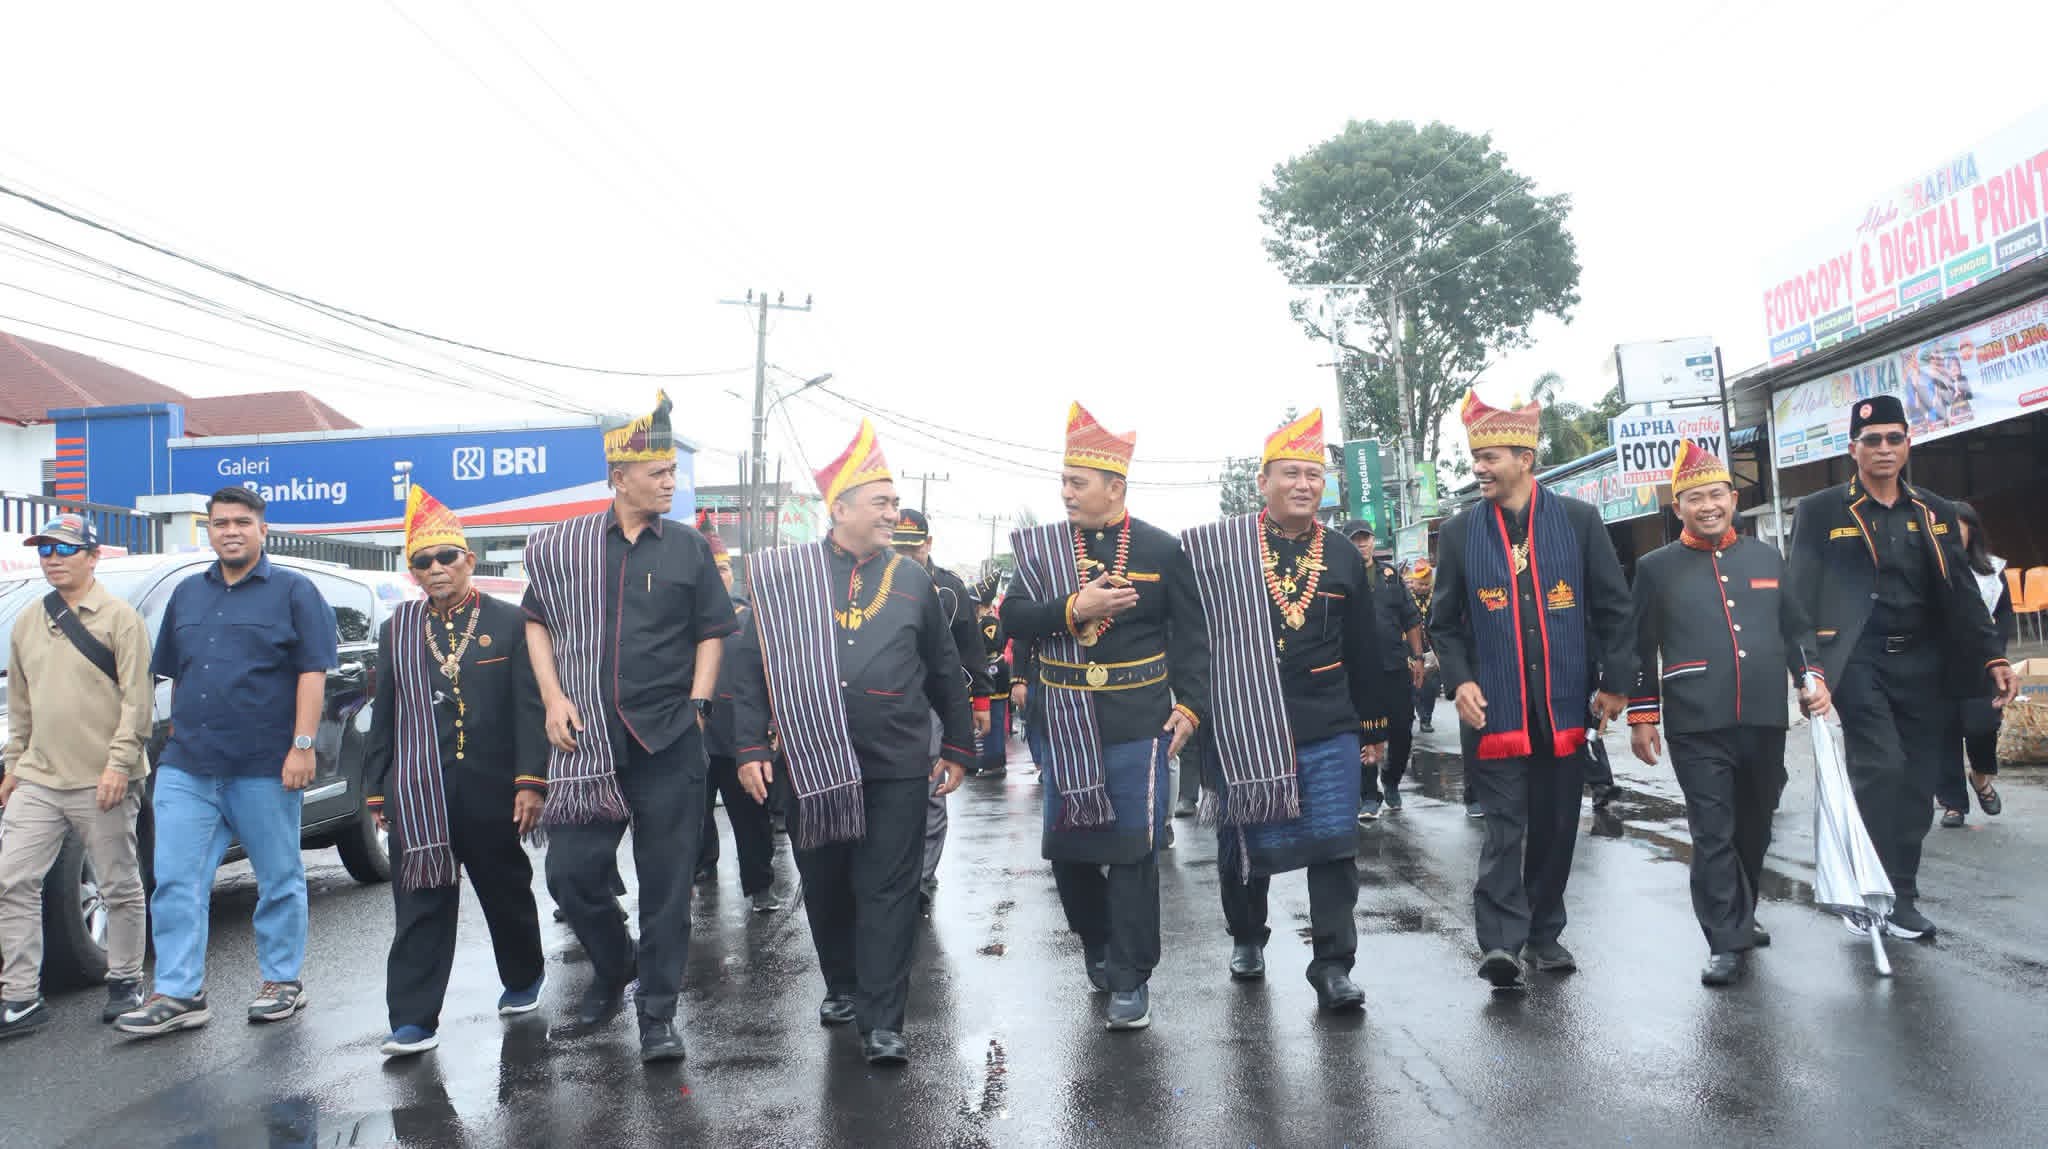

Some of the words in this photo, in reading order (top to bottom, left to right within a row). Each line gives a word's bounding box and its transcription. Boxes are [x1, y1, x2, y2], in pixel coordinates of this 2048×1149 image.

[1764, 250, 1853, 336] FOTOCOPY
[1861, 242, 1876, 293] &
[1880, 198, 1968, 286] DIGITAL
[1620, 419, 1675, 438] ALPHA
[217, 456, 271, 476] Galeri
[493, 446, 546, 475] BRI
[1622, 436, 1721, 472] FOTOCPY
[1358, 448, 1371, 503] Pegadaian
